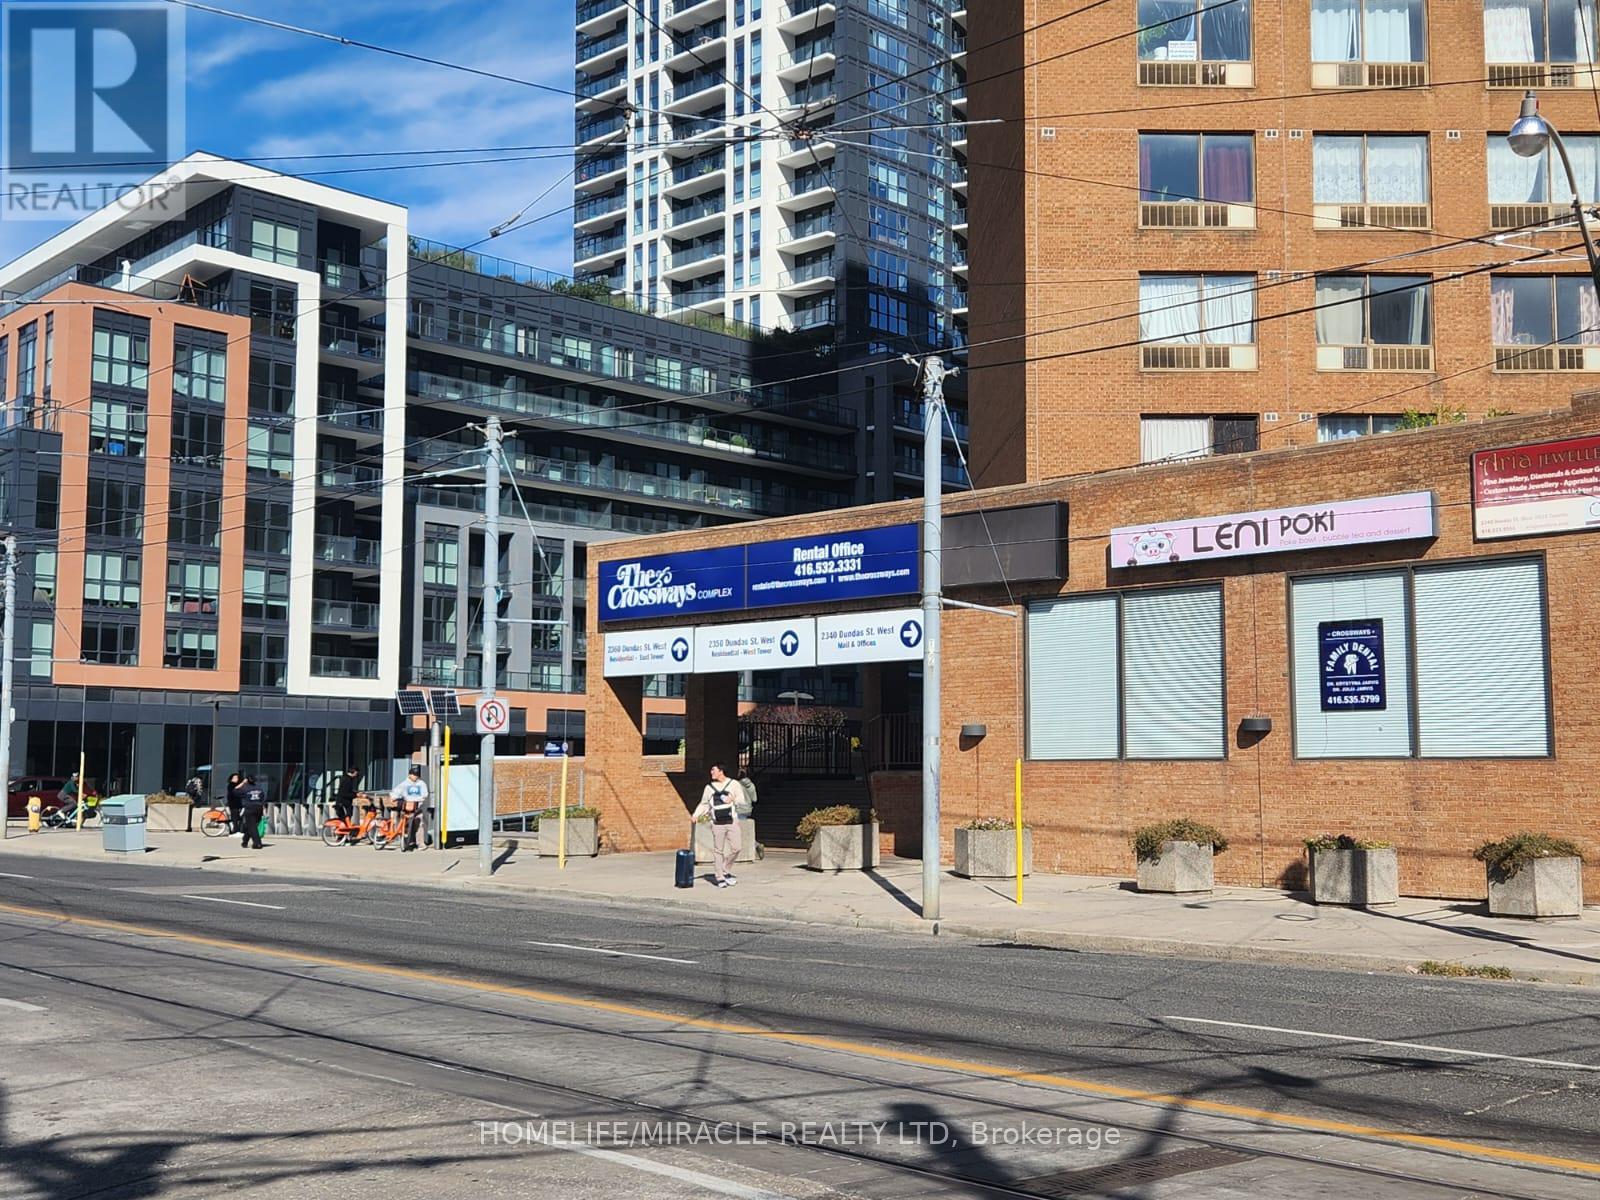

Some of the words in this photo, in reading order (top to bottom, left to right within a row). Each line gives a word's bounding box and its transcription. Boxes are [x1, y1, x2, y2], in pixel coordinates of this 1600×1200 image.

[1479, 451, 1531, 476] Aria
[1530, 470, 1564, 480] Diamonds
[1571, 467, 1594, 476] Colour
[1483, 487, 1508, 495] Custom
[1509, 484, 1527, 492] Made
[1528, 481, 1559, 490] Jewellery
[1563, 476, 1598, 487] Appraisals
[1279, 509, 1335, 537] POKI
[1383, 527, 1410, 536] dessert
[793, 545, 829, 562] Rental
[832, 541, 865, 558] Office
[794, 557, 862, 577] 416.532.3331
[617, 563, 673, 588] The
[607, 582, 697, 610] Crossways
[697, 587, 733, 600] COMPLEX
[821, 631, 837, 640] 2340
[839, 629, 864, 639] Dundas
[866, 627, 875, 636] St.
[877, 625, 894, 635] West
[1331, 628, 1371, 637] CROSSWAYS
[622, 643, 643, 652] Dundas
[644, 643, 652, 651] St.
[653, 641, 667, 650] West
[709, 640, 724, 648] 2350
[725, 637, 749, 646] Dundas
[750, 636, 759, 645] St.
[760, 635, 775, 644] West
[851, 640, 855, 648] &
[857, 639, 877, 647] Offices
[609, 655, 635, 663] Residential
[711, 649, 739, 657] Residential
[743, 648, 756, 656] West
[757, 647, 772, 655] Tower
[1325, 642, 1349, 672] FAMILY
[1351, 641, 1379, 671] DENTAL
[1327, 694, 1380, 704] 416.535.5799
